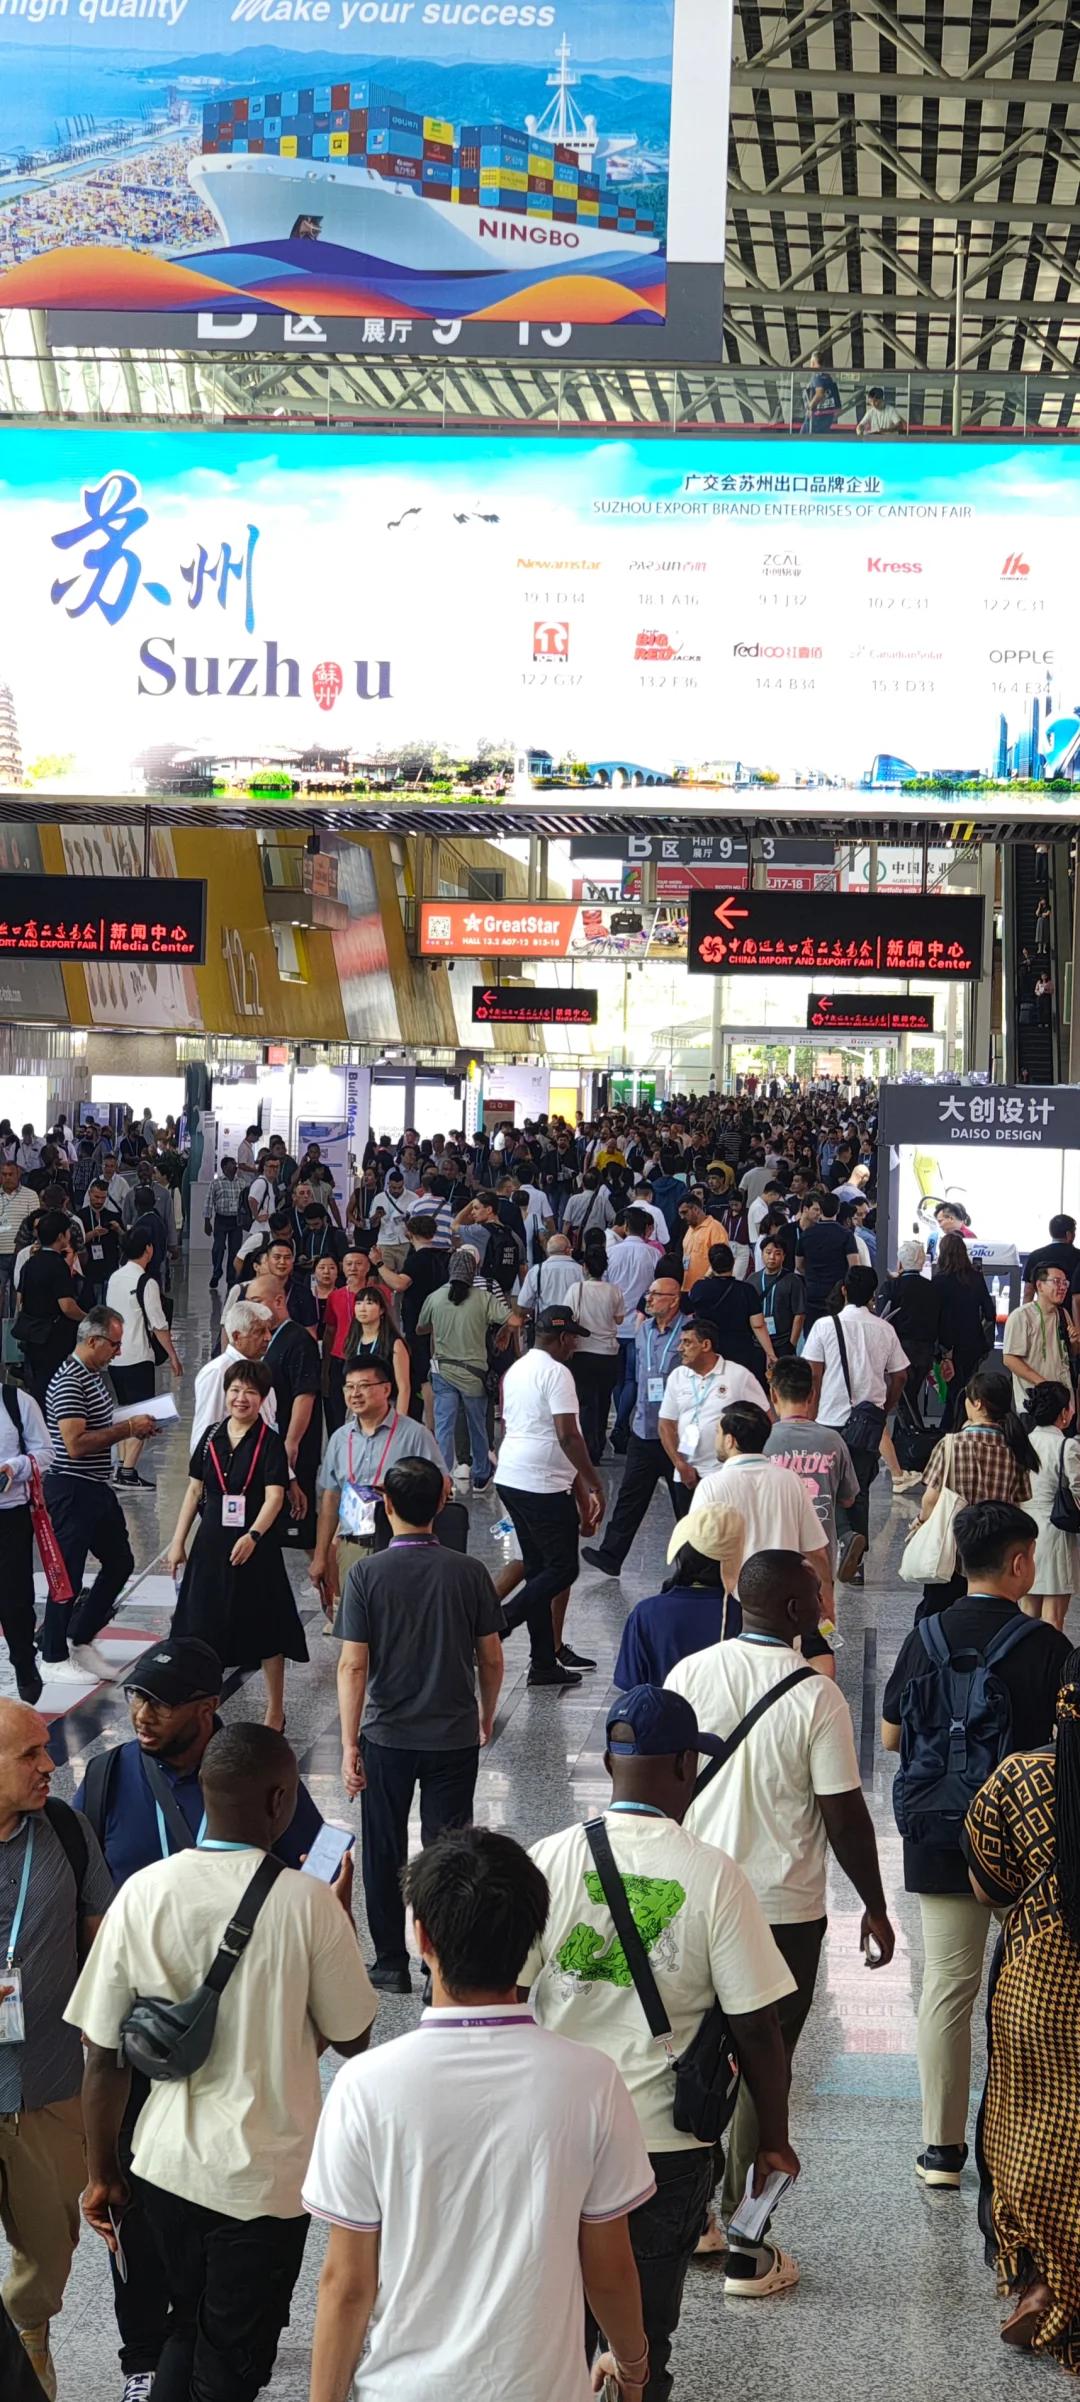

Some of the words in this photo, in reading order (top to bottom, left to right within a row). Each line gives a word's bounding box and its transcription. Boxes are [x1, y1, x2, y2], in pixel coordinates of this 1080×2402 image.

[78, 0, 188, 26] quality
[230, 0, 331, 22] Make
[338, 1, 414, 29] your
[421, 4, 556, 27] success
[479, 218, 580, 248] NINGBO
[684, 473, 881, 494] 广交会苏州出口品牌企业
[593, 501, 652, 514] SUZHOU
[656, 502, 709, 515] EXPORT
[713, 503, 761, 515] BRAND
[765, 504, 851, 517] ENTERPRISES
[855, 505, 875, 517] OF
[878, 505, 937, 518] CANTON
[941, 506, 972, 518] FAIR
[50, 474, 259, 635] 苏州
[516, 558, 601, 570] Newamstar
[867, 557, 923, 574] Kress
[556, 593, 586, 604] D34
[671, 594, 699, 605] A16
[636, 633, 669, 646] BIG
[989, 650, 1054, 664] OPPLE
[789, 679, 815, 690] B34
[905, 680, 935, 692] D33
[1024, 682, 1051, 694] E34
[628, 836, 653, 858] B
[662, 841, 680, 858] 区
[692, 837, 713, 847] Hall
[692, 848, 713, 859] 展厅
[484, 916, 560, 934] GreatStar
[110, 923, 188, 942] 新闻中心
[18, 940, 39, 948] AND
[40, 940, 75, 949] EXPORT
[77, 941, 98, 950] FAIR
[109, 940, 149, 951] Media
[151, 942, 195, 953] Center
[483, 938, 499, 946] 13.2
[501, 938, 529, 946] A07-12
[887, 939, 964, 959] 新闻中心
[728, 955, 757, 965] CHINA
[758, 956, 793, 965] IMPORT
[794, 956, 815, 966] AND
[816, 957, 851, 967] EXPORT
[853, 958, 874, 967] FAIR
[886, 956, 925, 968] Media
[928, 958, 972, 970] Center
[938, 1095, 1055, 1126] 大创设计
[951, 1128, 991, 1140] DAISO
[995, 1129, 1042, 1141] DESIGN
[785, 1449, 808, 1459] ARE
